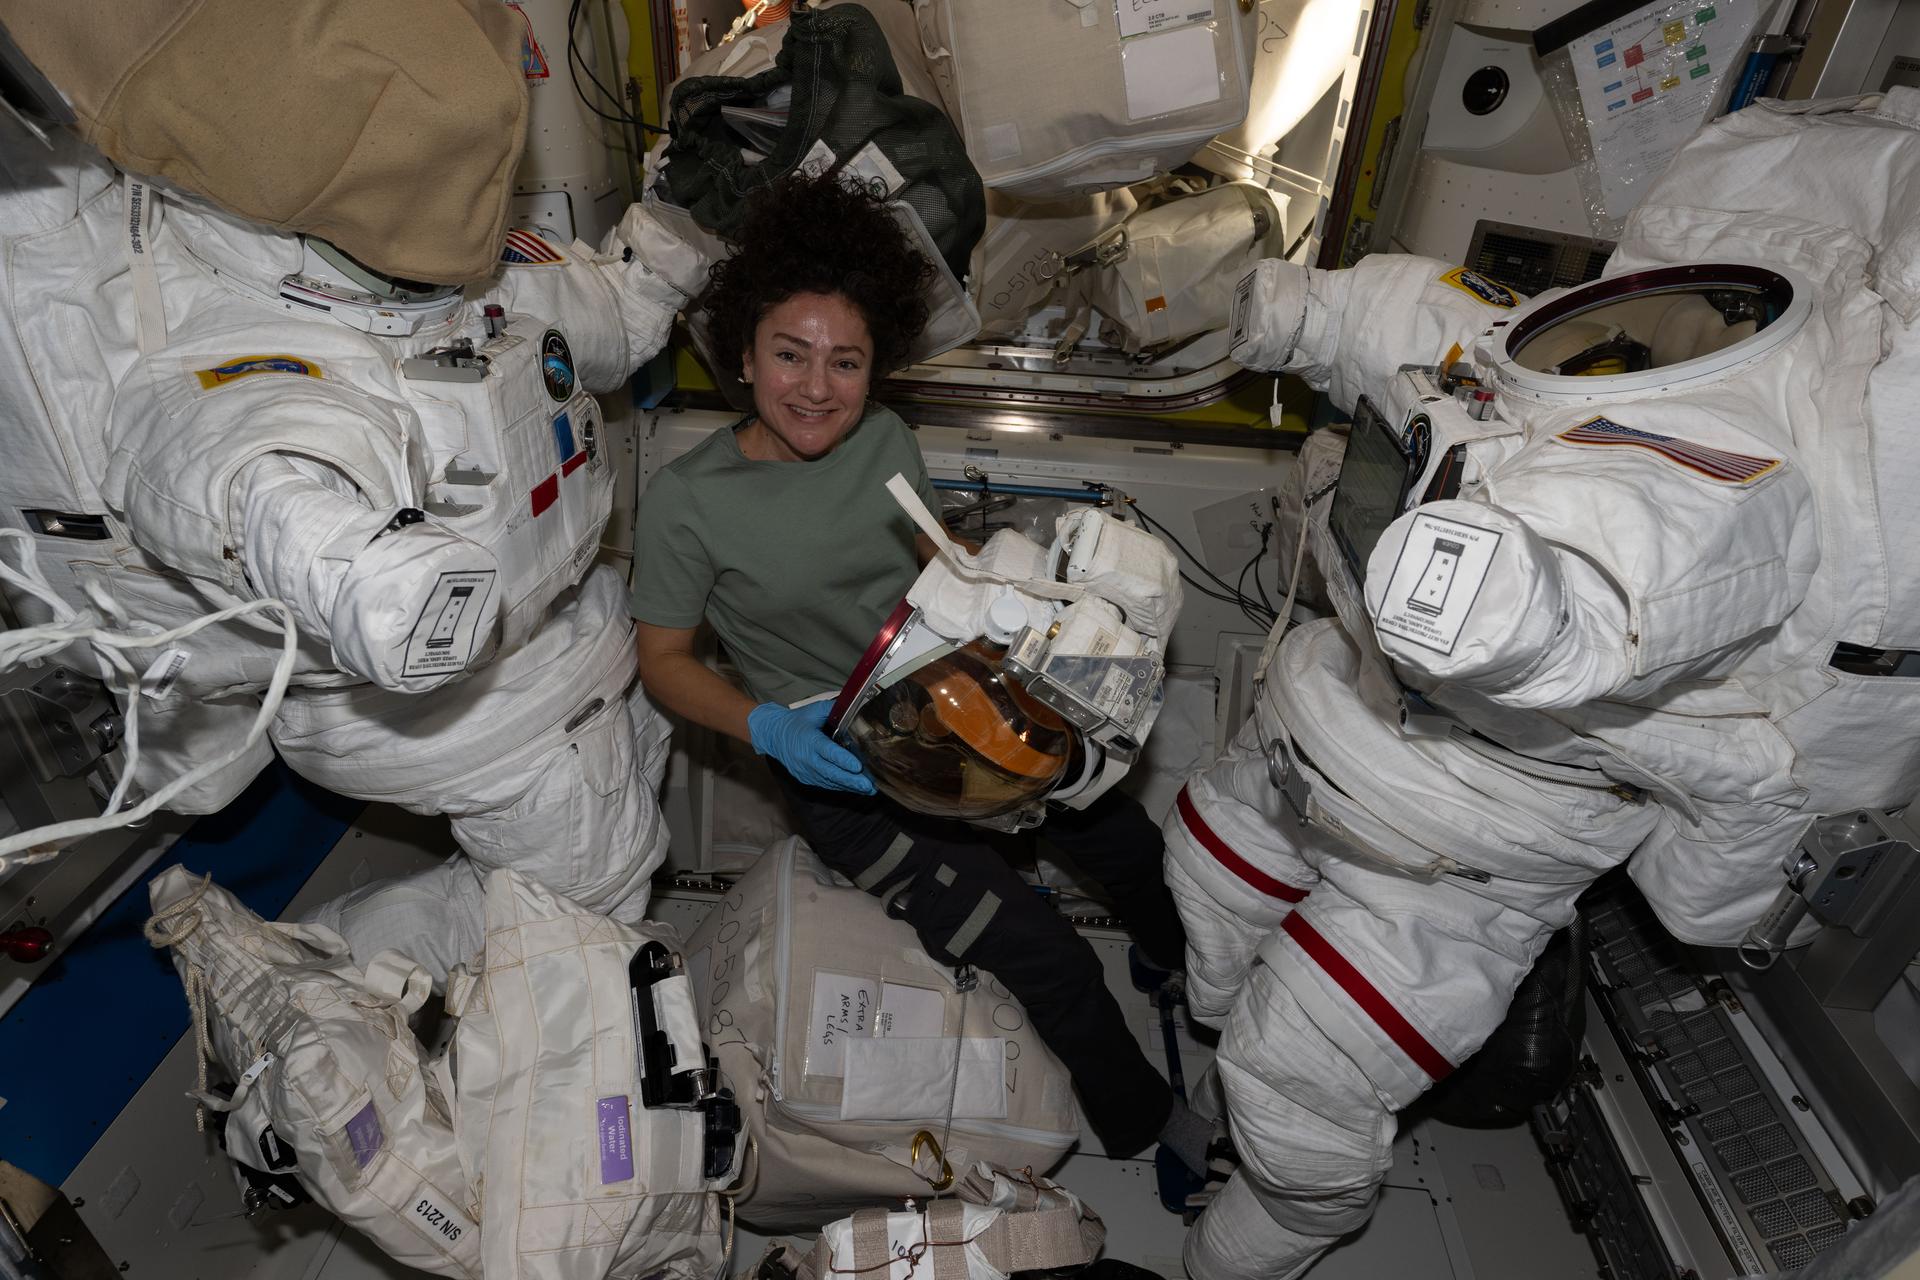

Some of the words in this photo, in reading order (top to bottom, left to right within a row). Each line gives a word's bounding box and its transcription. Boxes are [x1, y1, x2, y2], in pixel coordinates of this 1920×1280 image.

[131, 184, 143, 197] P/N
[856, 989, 870, 1032] EXTRA
[823, 1015, 835, 1046] LEGS
[608, 1125, 616, 1153] Water
[617, 1115, 628, 1160] Iodinated
[415, 1198, 445, 1227] 2213
[439, 1220, 462, 1242] S/N
